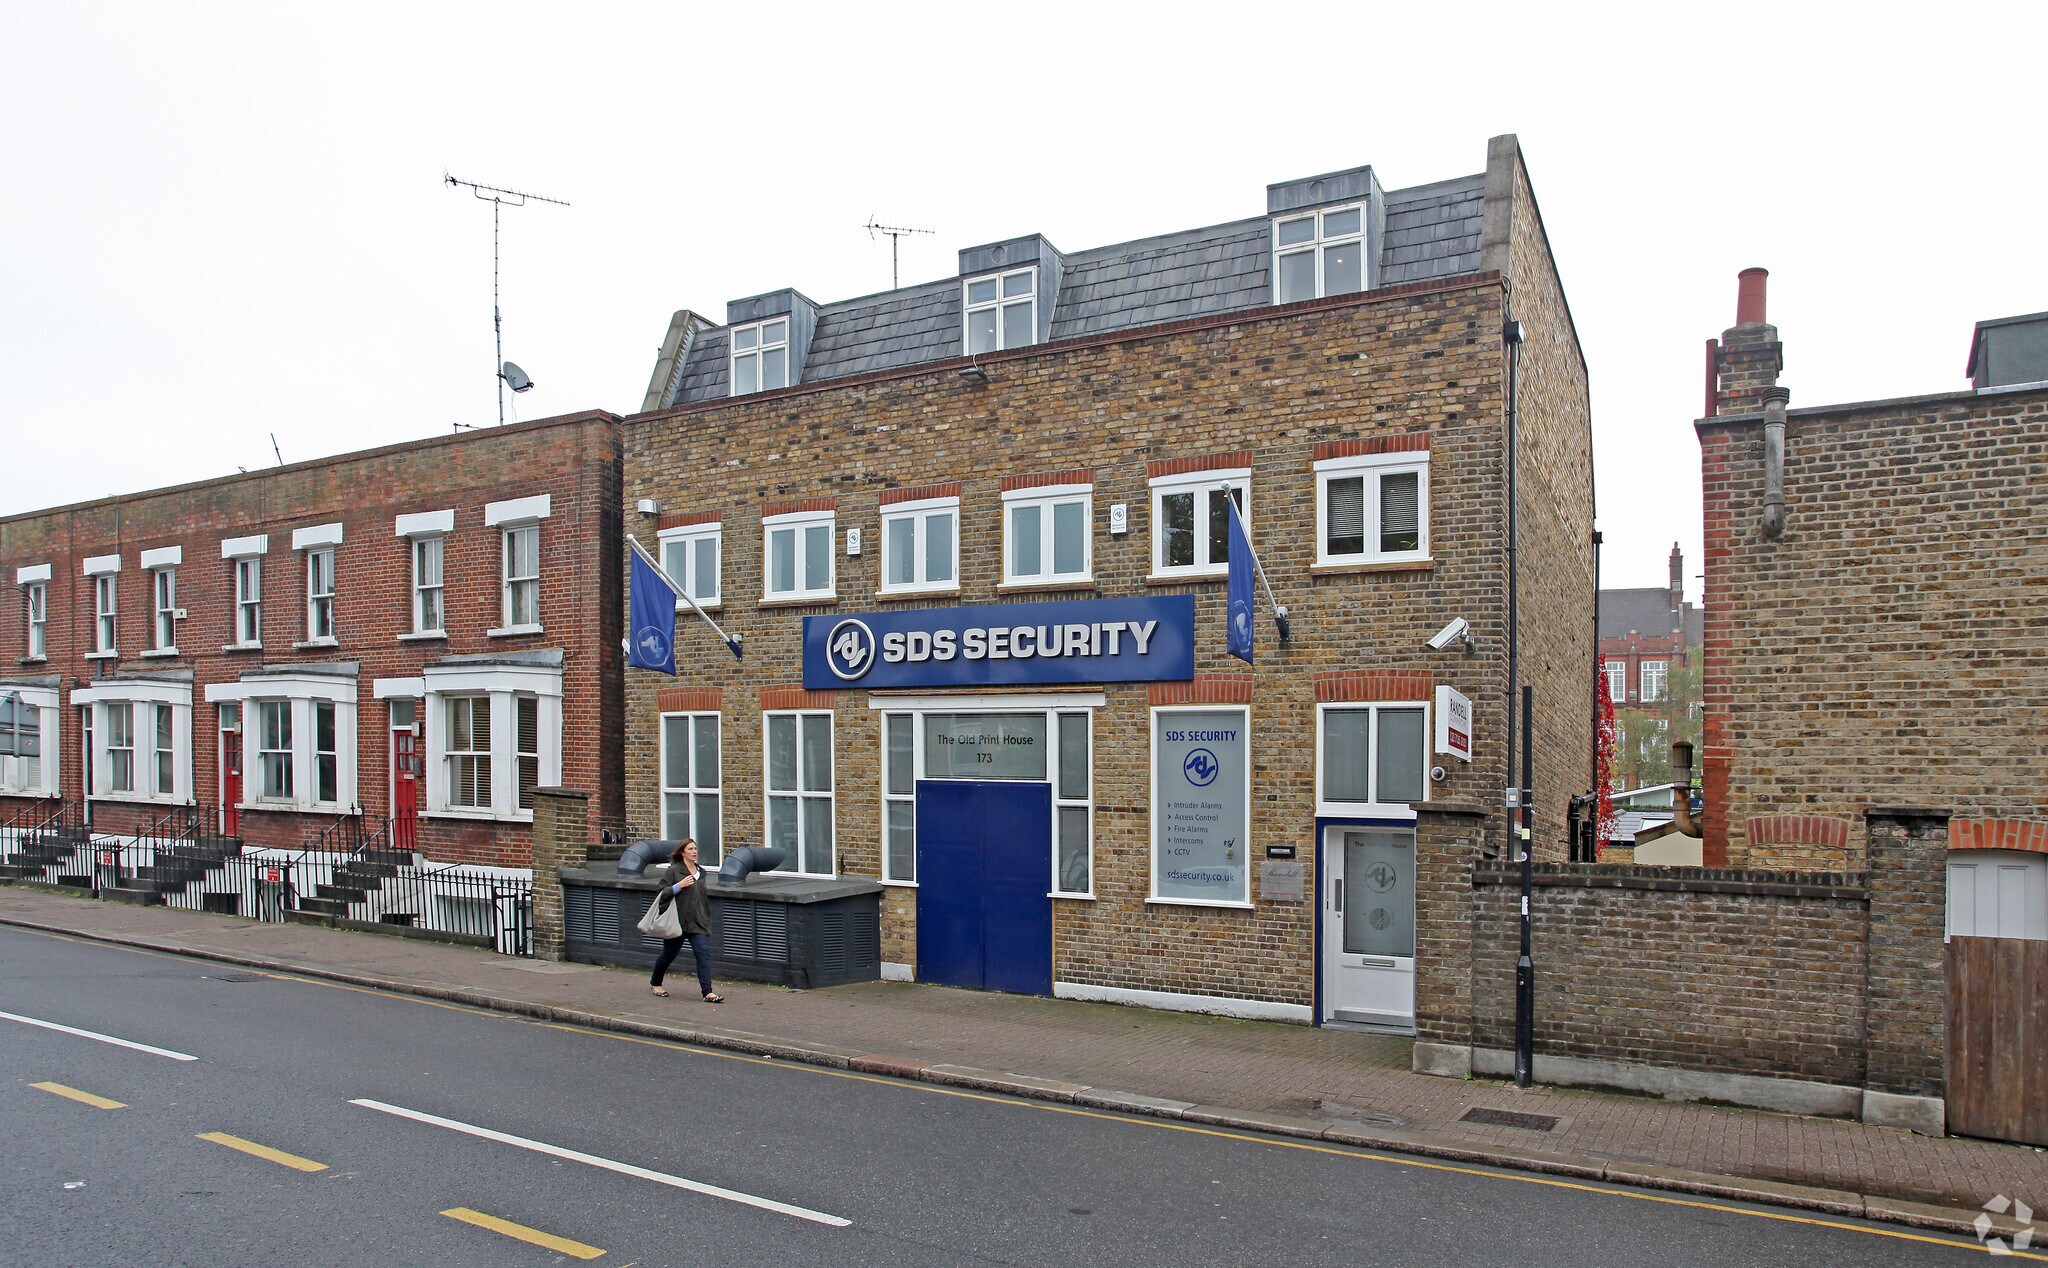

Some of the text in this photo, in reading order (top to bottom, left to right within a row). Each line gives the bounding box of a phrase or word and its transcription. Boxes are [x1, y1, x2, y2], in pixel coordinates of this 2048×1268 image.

[882, 620, 1159, 663] SDS SECURITY
[938, 734, 1034, 745] The Old Print House
[1165, 730, 1237, 742] SDS SECURITY
[977, 753, 993, 763] 173
[1200, 802, 1222, 810] Alarms
[1174, 813, 1219, 821] Access Control
[1187, 825, 1208, 833] Alarms
[1173, 837, 1204, 845] Intercoms
[1174, 848, 1190, 856] CCTV
[1167, 870, 1235, 882] sdssecurity.co.uk
